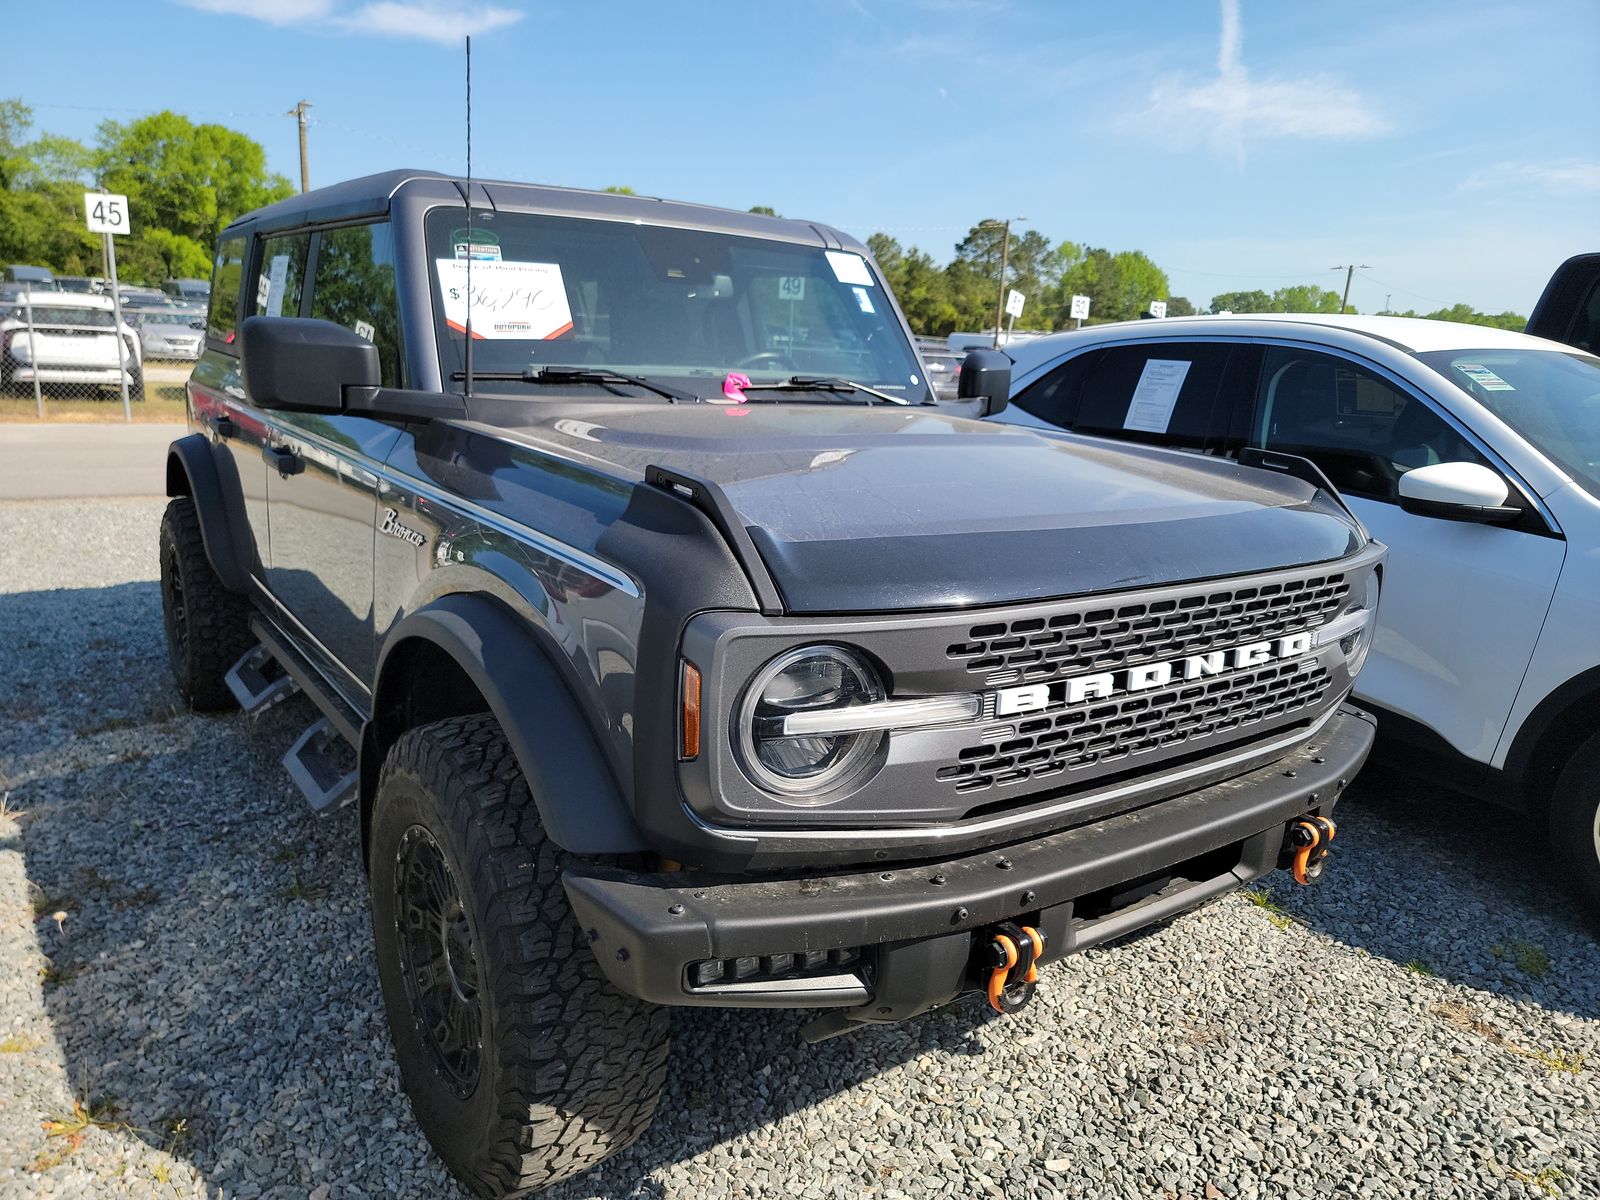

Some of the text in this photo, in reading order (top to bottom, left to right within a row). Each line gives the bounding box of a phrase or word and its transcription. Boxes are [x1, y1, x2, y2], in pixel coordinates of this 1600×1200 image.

[93, 200, 121, 225] 45
[783, 278, 801, 295] 49
[1075, 300, 1085, 314] 52
[379, 507, 426, 547] Bronco
[997, 632, 1312, 716] BRONCO
